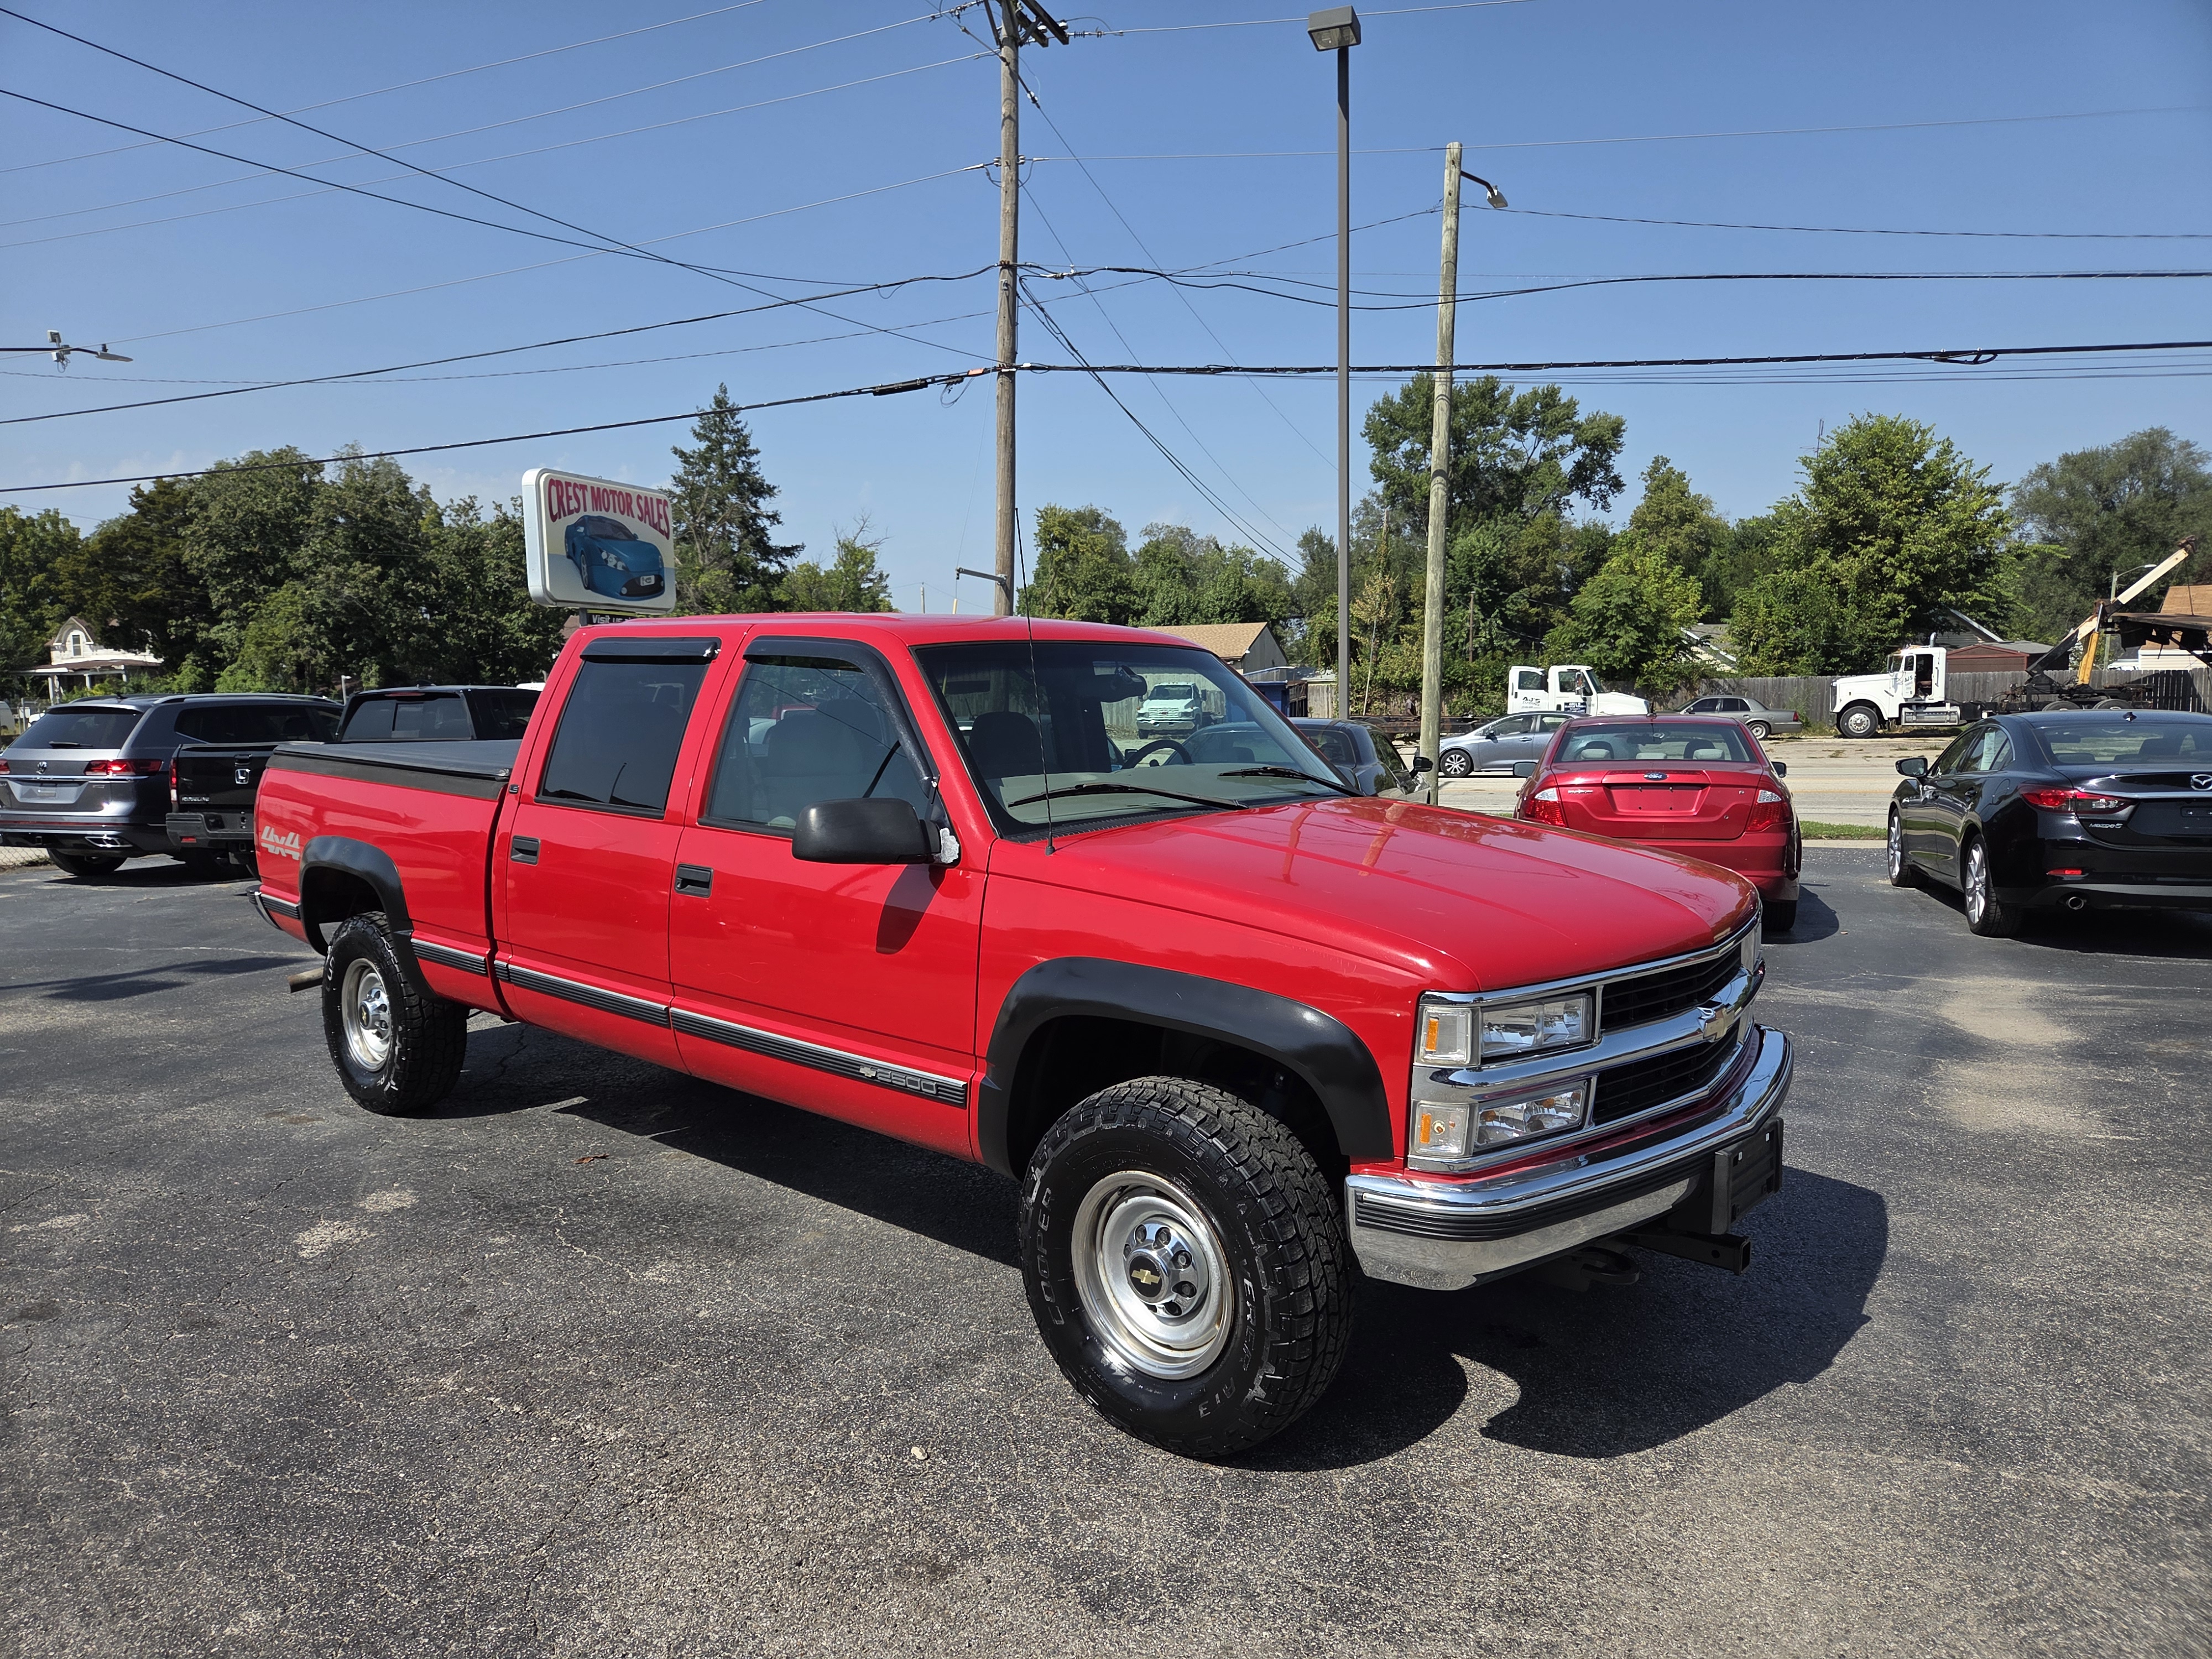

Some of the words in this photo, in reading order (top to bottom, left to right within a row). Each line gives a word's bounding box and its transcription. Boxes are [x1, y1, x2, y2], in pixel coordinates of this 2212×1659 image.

[548, 478, 588, 523] CREST
[591, 486, 635, 519] MOTOR
[637, 494, 670, 540] SALES
[592, 614, 611, 624] Visit
[877, 1068, 937, 1094] 2500
[1036, 1187, 1065, 1325] COOPER
